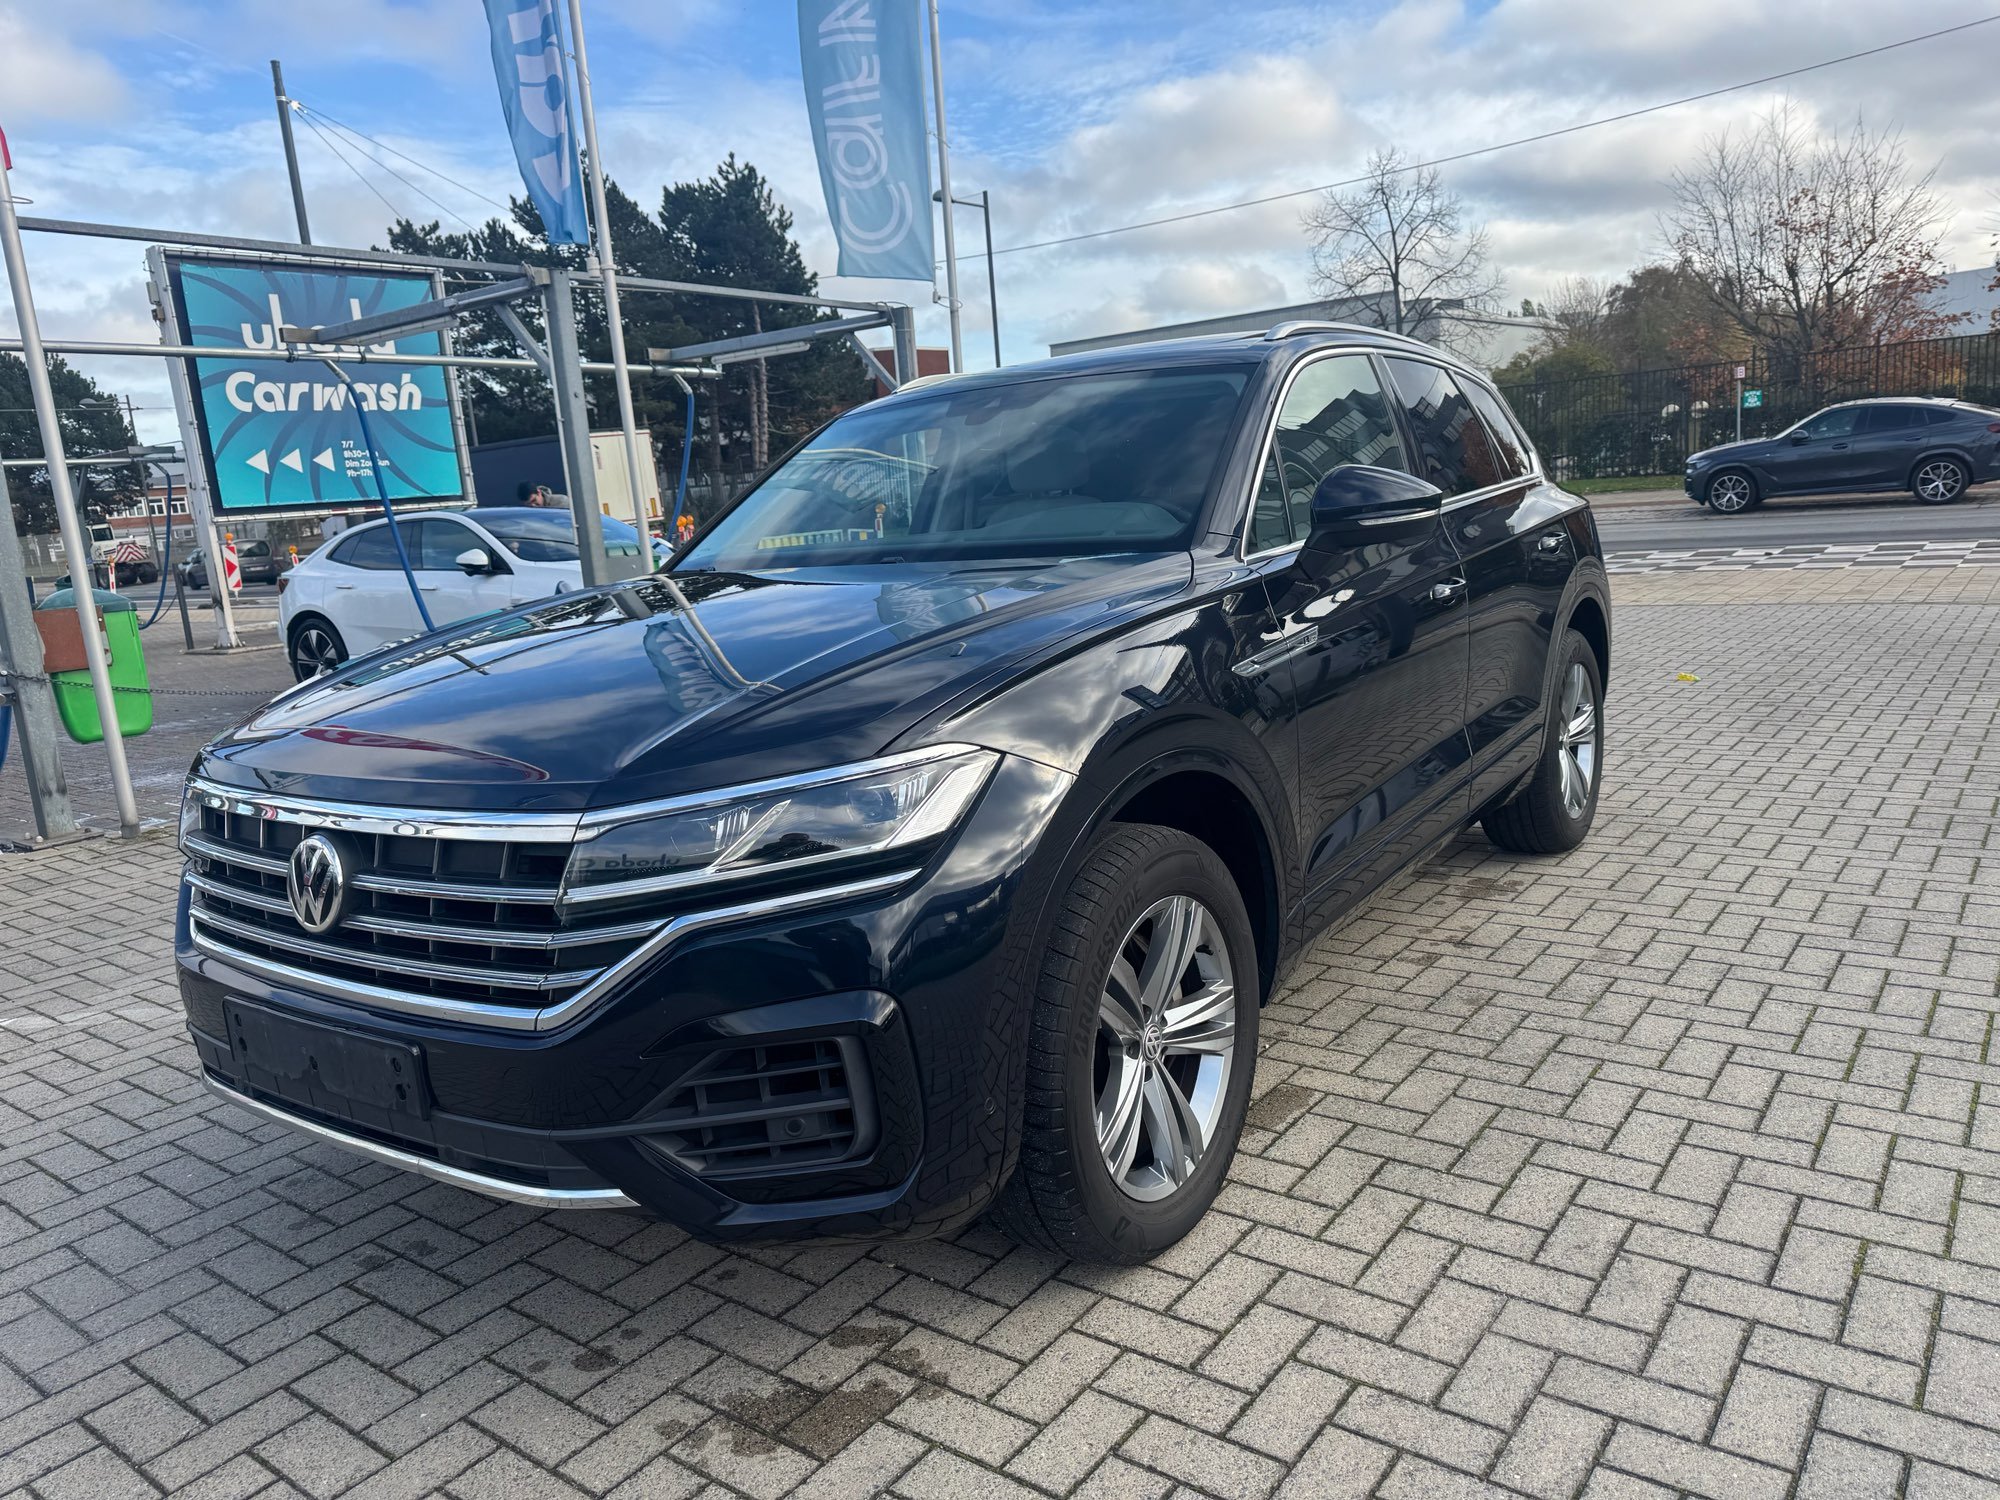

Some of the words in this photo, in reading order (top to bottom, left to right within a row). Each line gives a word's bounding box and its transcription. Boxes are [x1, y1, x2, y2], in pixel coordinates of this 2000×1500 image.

[225, 371, 422, 413] Carwash
[341, 440, 354, 449] 7/7
[1072, 880, 1145, 1061] BRIDGESTONE
